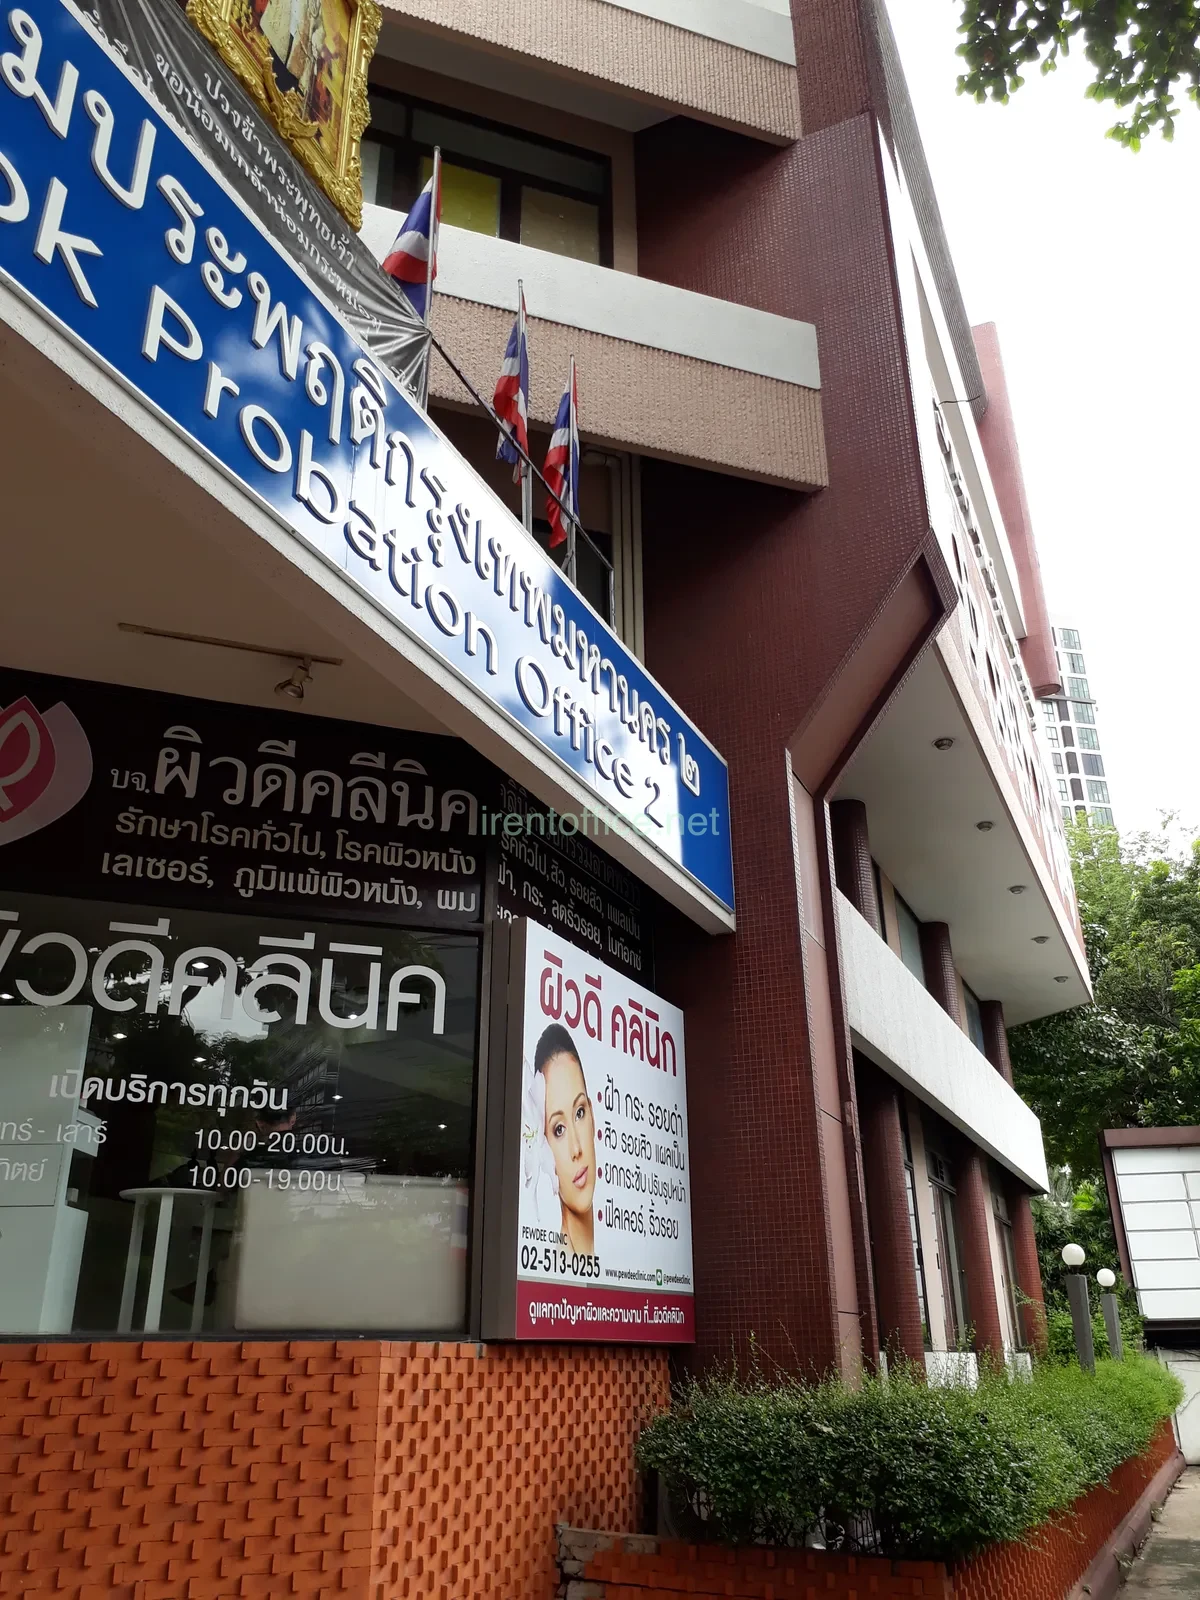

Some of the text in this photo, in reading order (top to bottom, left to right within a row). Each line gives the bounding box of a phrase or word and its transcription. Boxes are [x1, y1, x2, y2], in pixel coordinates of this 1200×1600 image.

[142, 284, 498, 676] Probation
[515, 655, 634, 799] Office
[644, 776, 666, 829] 2
[336, 830, 476, 875] โรคผิวหนัง
[102, 852, 214, 888] เลเซอร์,
[437, 888, 477, 912] ผม
[540, 949, 603, 1041] ผิวดี
[49, 1068, 289, 1116] เปิดบริการทุกวัน
[604, 1074, 683, 1138] ฝ้า กระ รอยดำ
[56, 1120, 108, 1144] เสาร์
[194, 1128, 350, 1156] 10.00-20.00น.
[604, 1120, 618, 1150] สิว
[621, 1132, 652, 1161] รอยสิว
[189, 1165, 346, 1191] 10.00-19.00น.
[522, 1226, 568, 1246] PEWDEE CLINIC
[521, 1244, 601, 1278] 02-513-0255
[604, 1269, 656, 1282] www.pewdeeclinic.com
